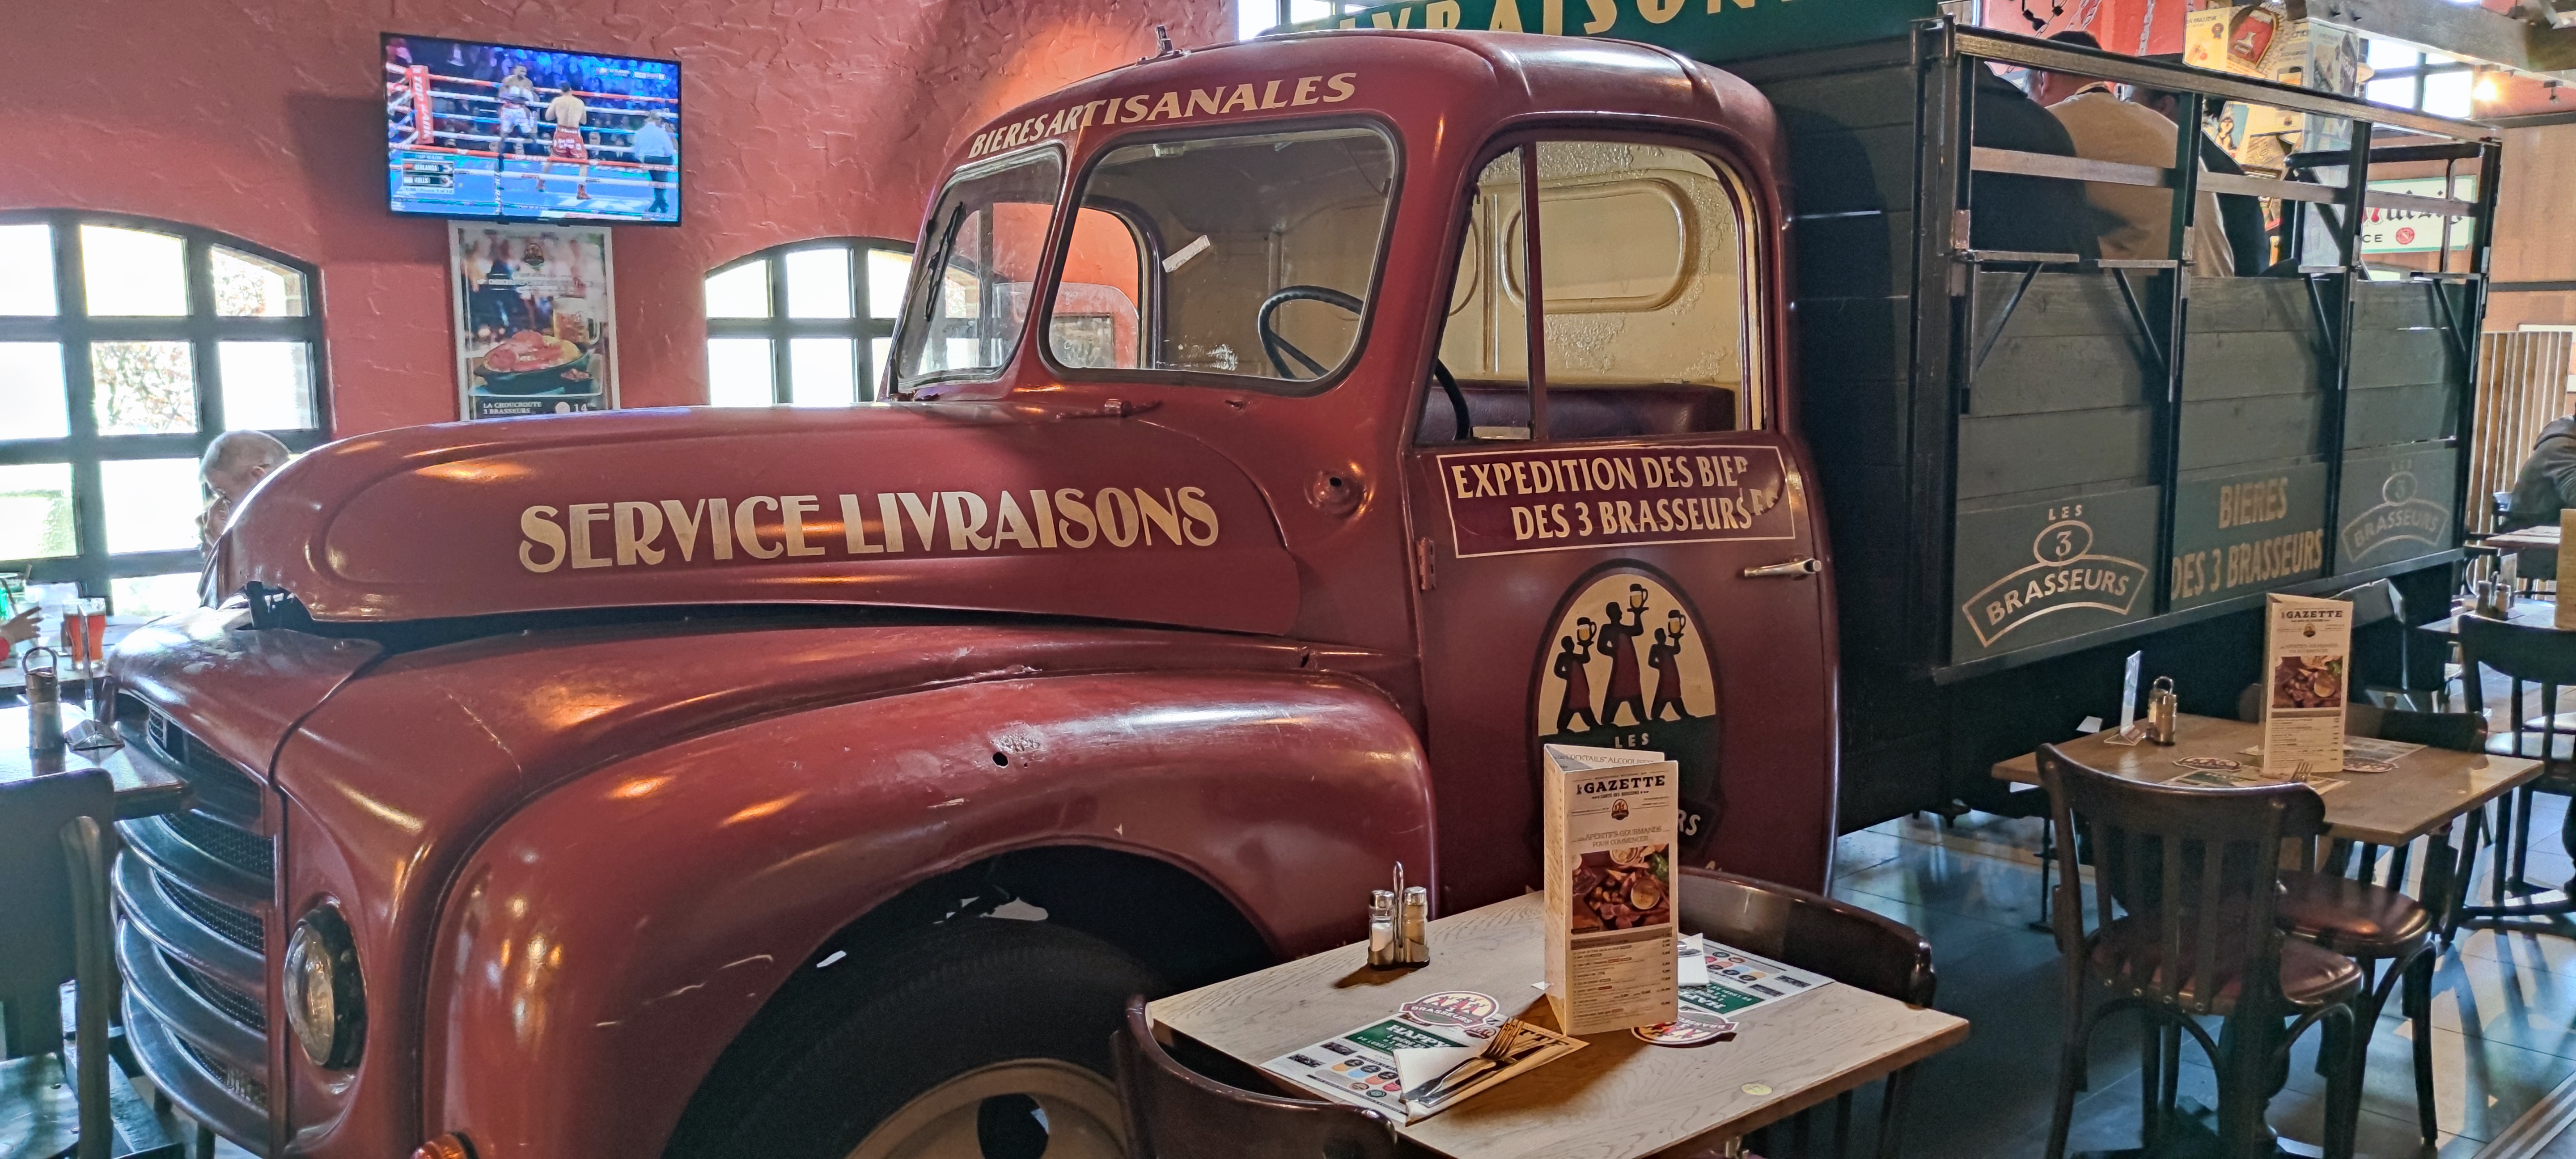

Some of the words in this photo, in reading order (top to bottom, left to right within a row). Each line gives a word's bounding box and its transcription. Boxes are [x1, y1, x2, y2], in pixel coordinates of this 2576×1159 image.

[968, 116, 1045, 159] BIERES
[1044, 72, 1357, 138] ARTISANALES
[1451, 457, 1638, 499] EXPEDITION
[1640, 456, 1694, 489] DES
[1511, 503, 1570, 541] DES
[1576, 501, 1593, 537] 3
[1597, 497, 1752, 535] BRASSEURS
[2048, 504, 2082, 520] LES
[2219, 477, 2288, 529] BIERES
[519, 495, 825, 573] SERVICE
[840, 486, 1219, 555] LIVRAISONS
[2055, 530, 2072, 556] 3
[2354, 510, 2438, 548] BRASSEURS
[2171, 551, 2205, 601] DES
[2210, 549, 2221, 592] 3
[2227, 529, 2323, 588] BRASSEURS
[1986, 568, 2129, 626] BRASSEURS
[2286, 610, 2343, 618] GAZETTE
[1615, 732, 1649, 749] LES
[1584, 775, 1665, 794] GAZETTE
[1411, 1006, 1473, 1024] BRASSEURS
[1386, 1024, 1451, 1047] HAPPY
